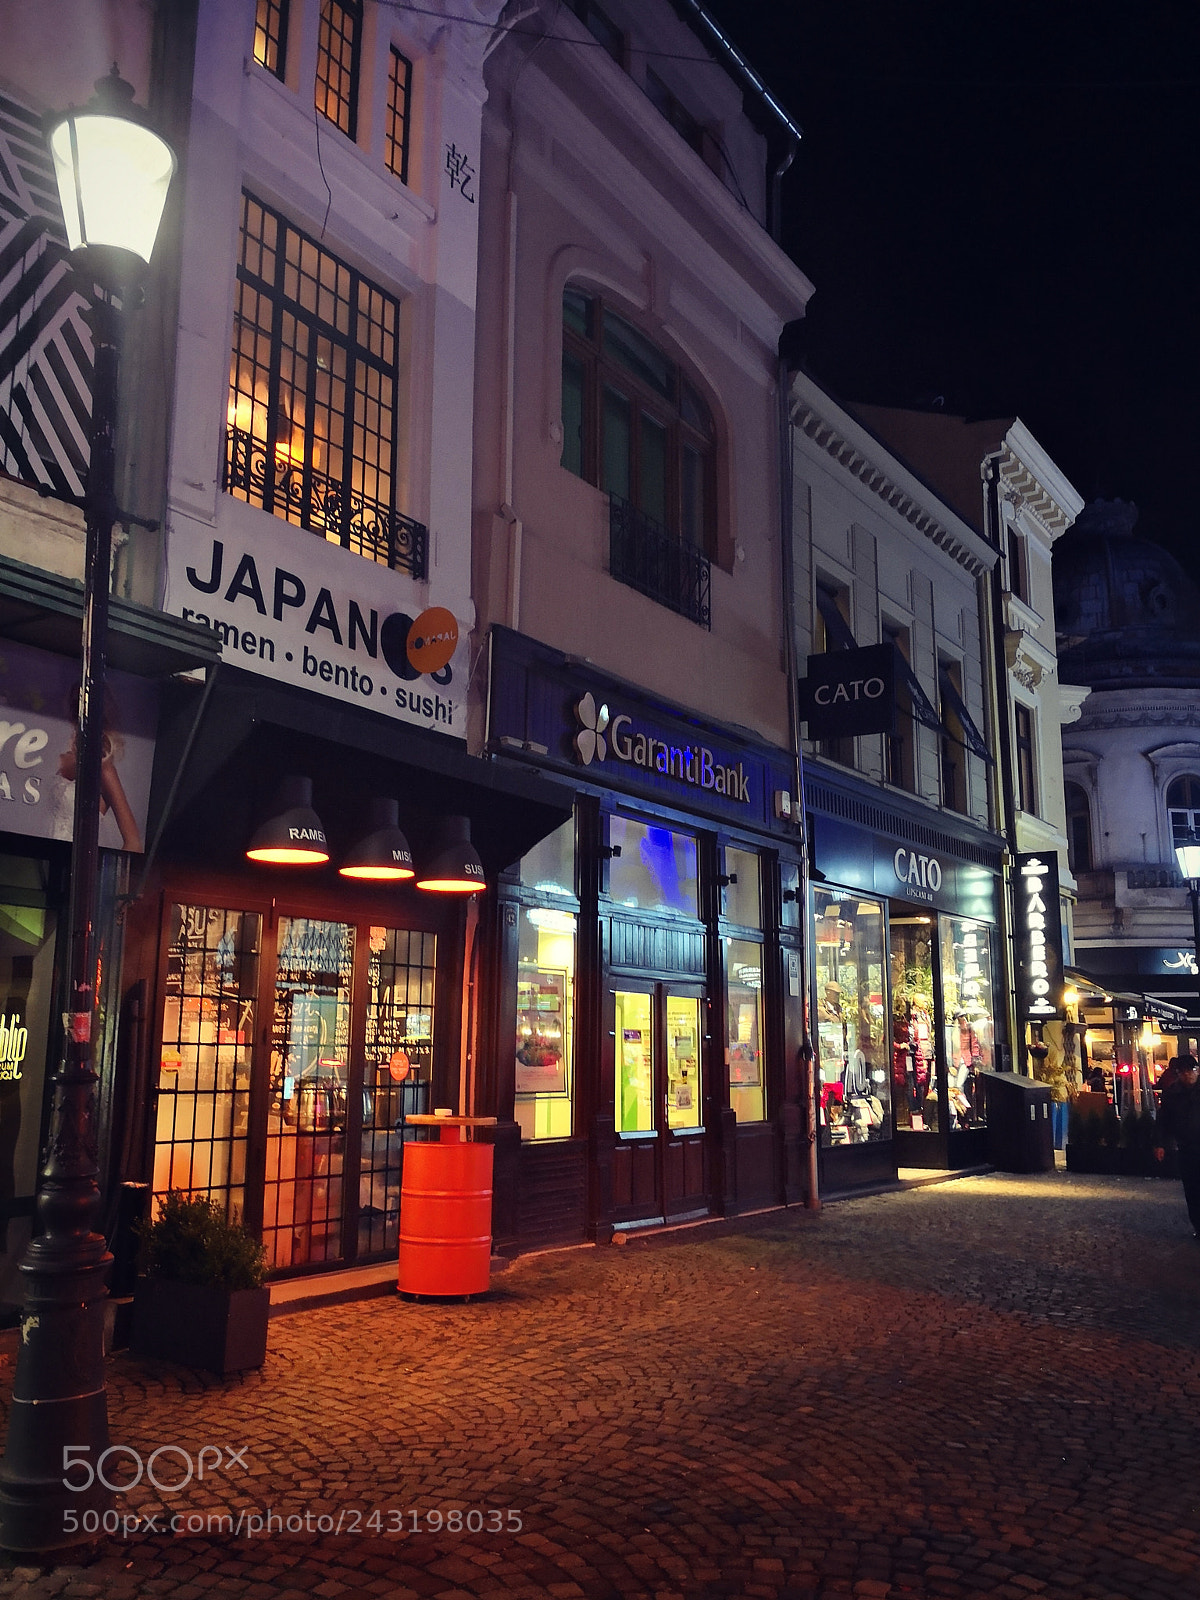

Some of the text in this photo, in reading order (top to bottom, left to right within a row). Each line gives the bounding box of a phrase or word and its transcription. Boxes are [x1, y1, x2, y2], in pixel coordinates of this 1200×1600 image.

[444, 143, 476, 204] 乾
[302, 646, 374, 697] bento
[394, 685, 454, 725] sushi
[814, 677, 885, 706] CATO
[611, 714, 751, 804] GarantiBank
[894, 847, 942, 892] CATO
[1026, 875, 1050, 996] BARBERO
